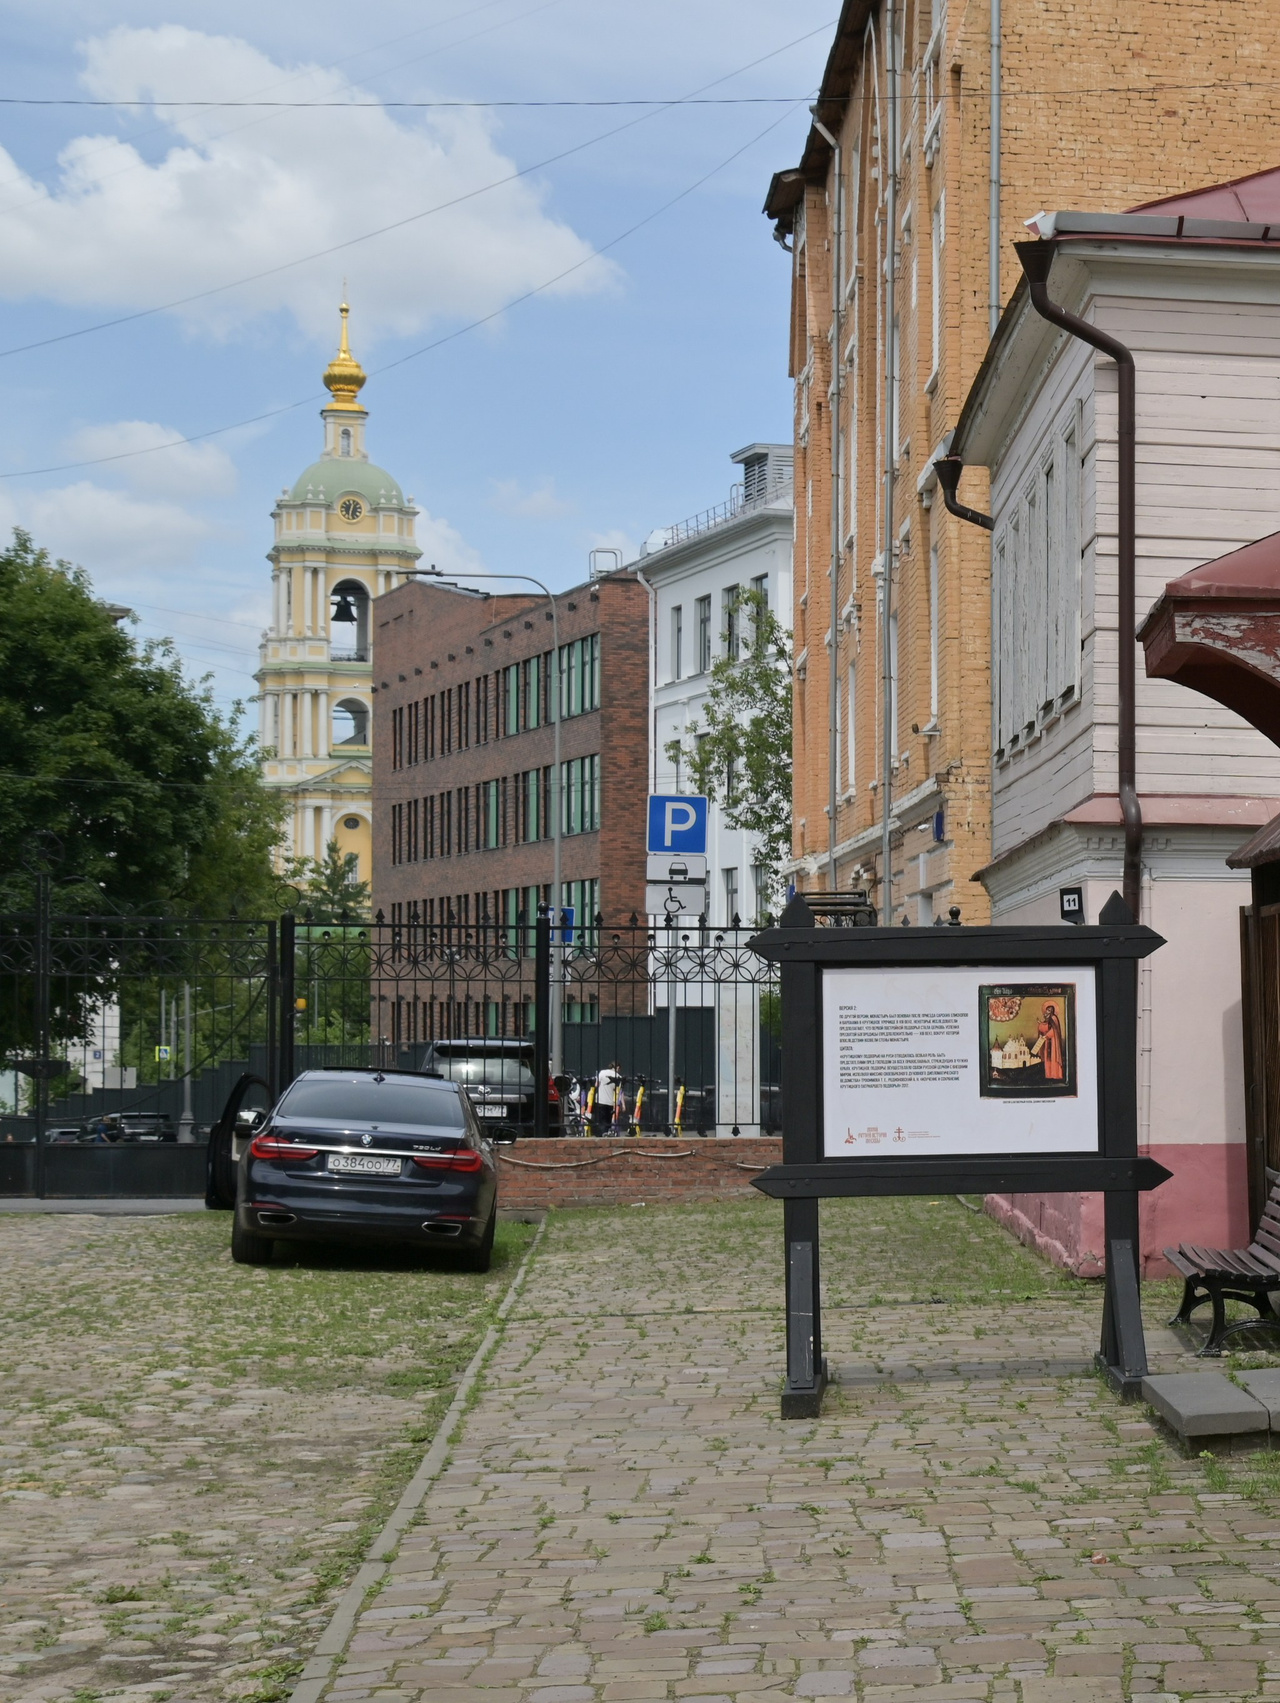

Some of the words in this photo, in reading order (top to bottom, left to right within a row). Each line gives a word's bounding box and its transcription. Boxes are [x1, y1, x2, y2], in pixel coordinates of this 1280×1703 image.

[664, 801, 697, 847] P
[1066, 898, 1077, 907] 11
[385, 1158, 397, 1168] 77
